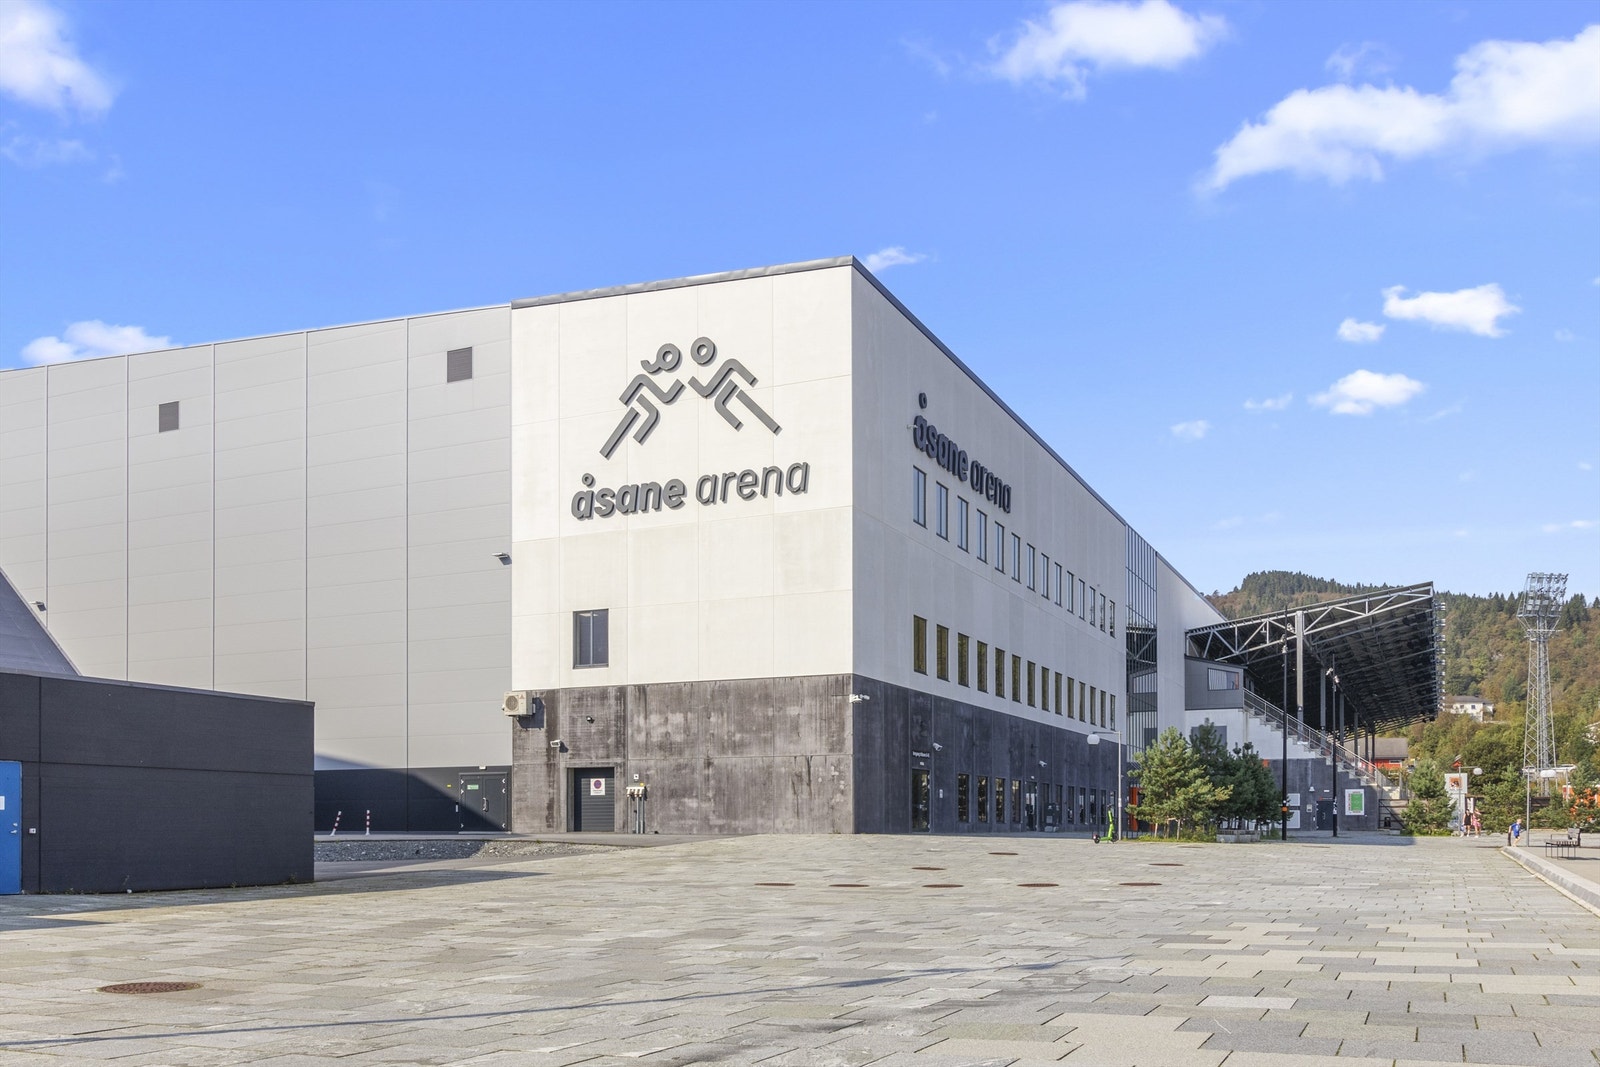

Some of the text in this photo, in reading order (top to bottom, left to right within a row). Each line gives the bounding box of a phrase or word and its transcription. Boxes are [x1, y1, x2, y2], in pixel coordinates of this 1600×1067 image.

[571, 461, 810, 520] åsane arena
[913, 392, 1011, 514] åsane arena
